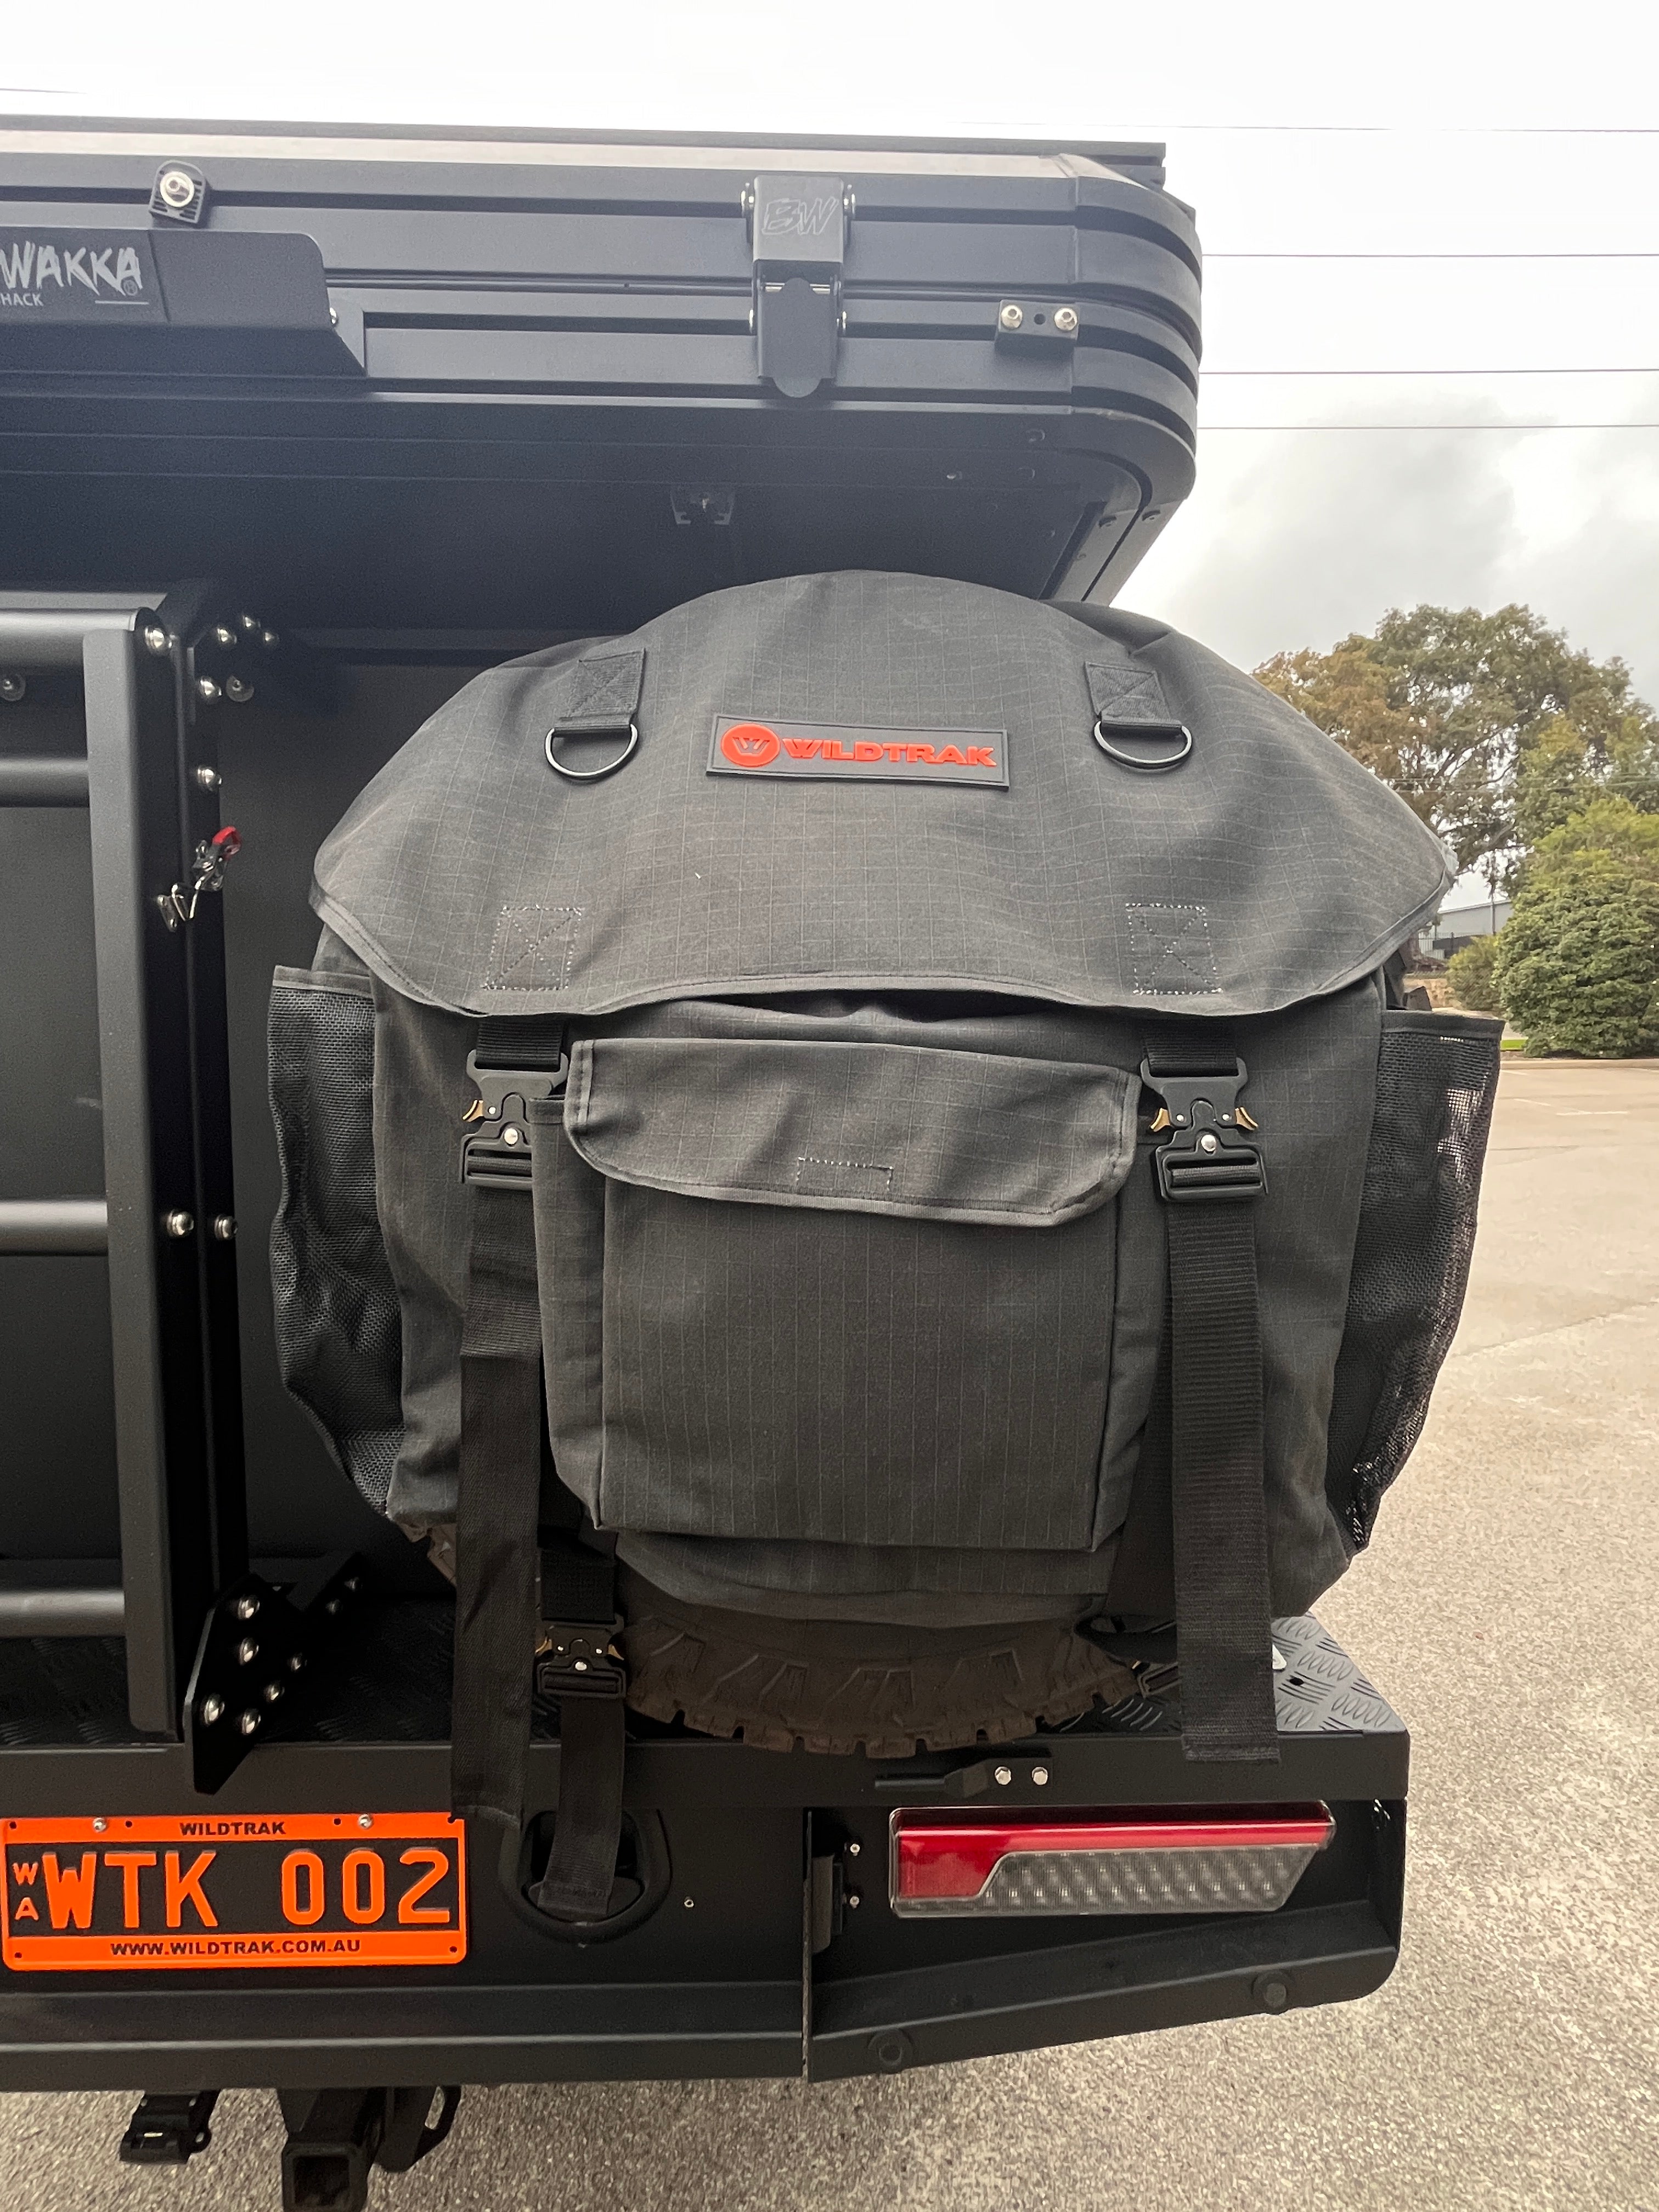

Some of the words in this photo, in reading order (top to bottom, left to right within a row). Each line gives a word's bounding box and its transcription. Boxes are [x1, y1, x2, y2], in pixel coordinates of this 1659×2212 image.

[782, 738, 997, 766] WILDTRAK
[179, 1822, 286, 1836] WILDTRAK
[42, 1850, 218, 1929] WTK
[281, 1847, 450, 1926] 002
[111, 1939, 360, 1956] WWW.WILDTRAK.COM.AU
